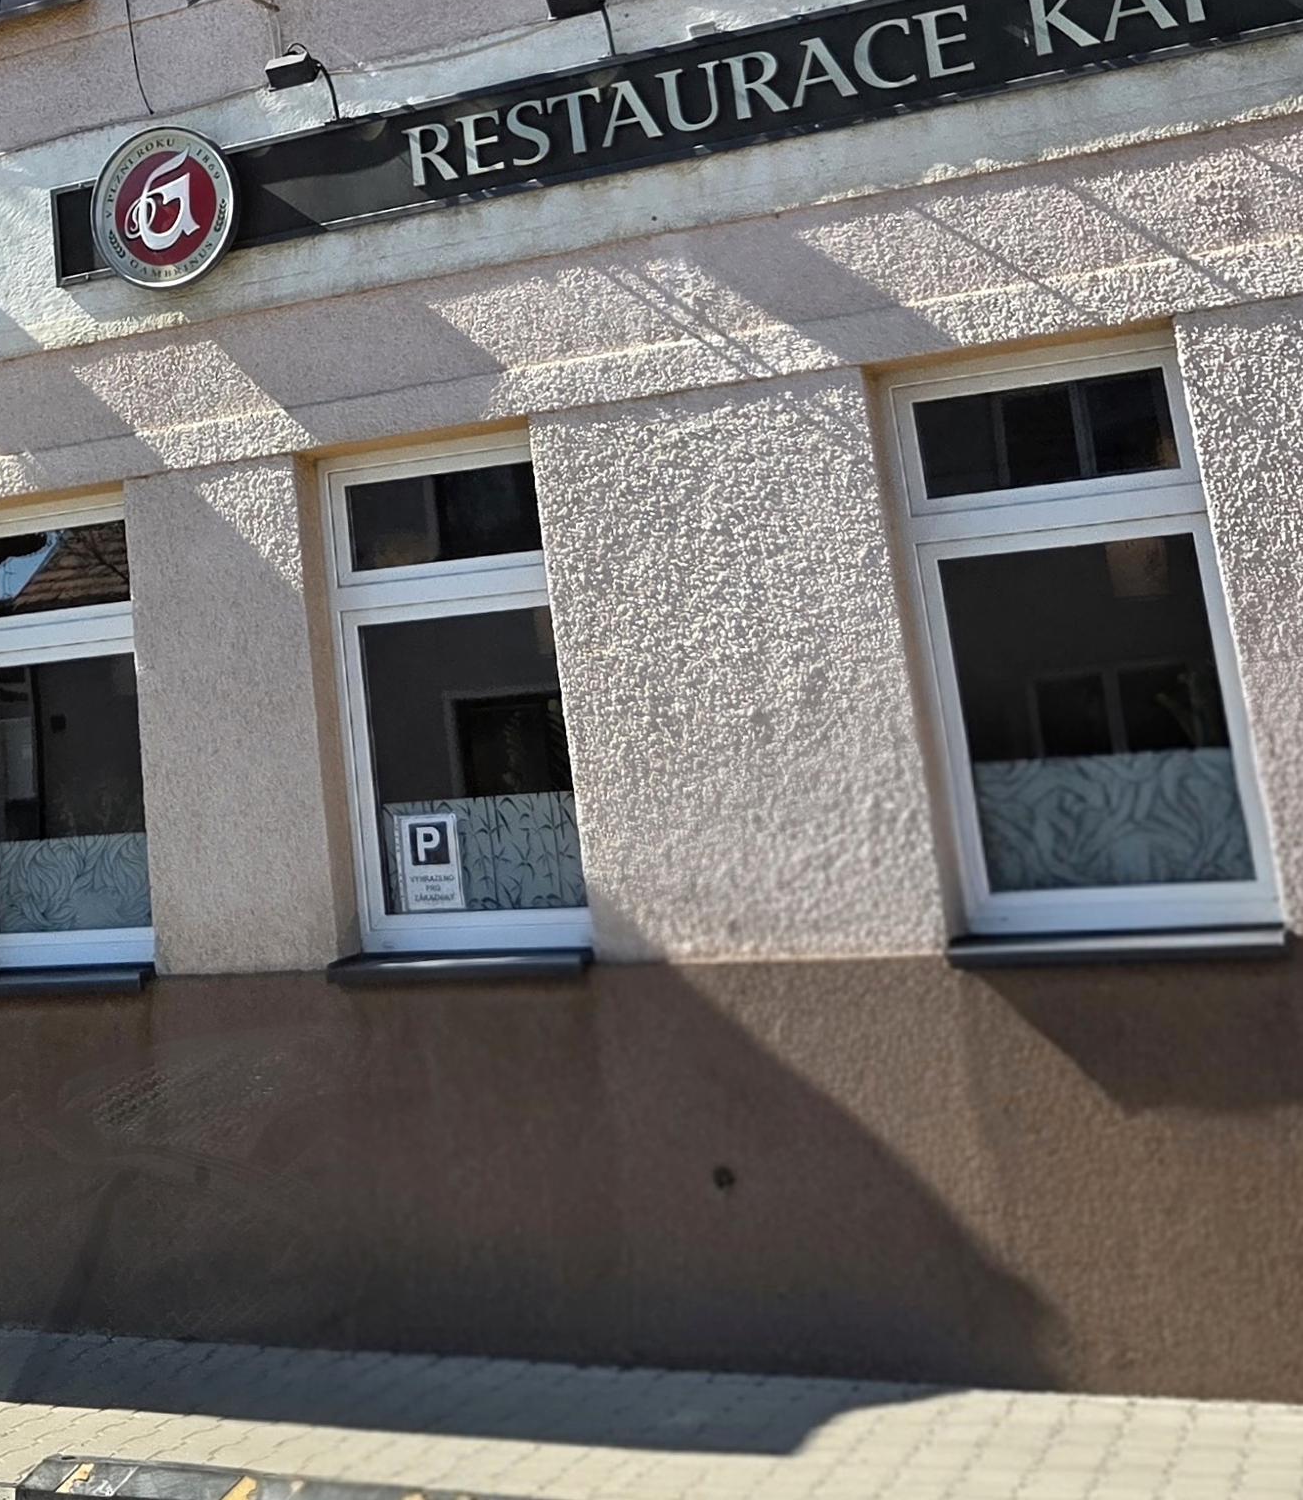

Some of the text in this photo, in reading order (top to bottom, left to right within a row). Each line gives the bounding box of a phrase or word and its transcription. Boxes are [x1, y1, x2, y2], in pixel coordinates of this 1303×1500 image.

[402, 4, 976, 188] RESTAURACE
[136, 138, 175, 157] ROKU
[196, 148, 220, 181] 1869
[130, 242, 213, 278] GAMBRINUS
[416, 826, 440, 862] P
